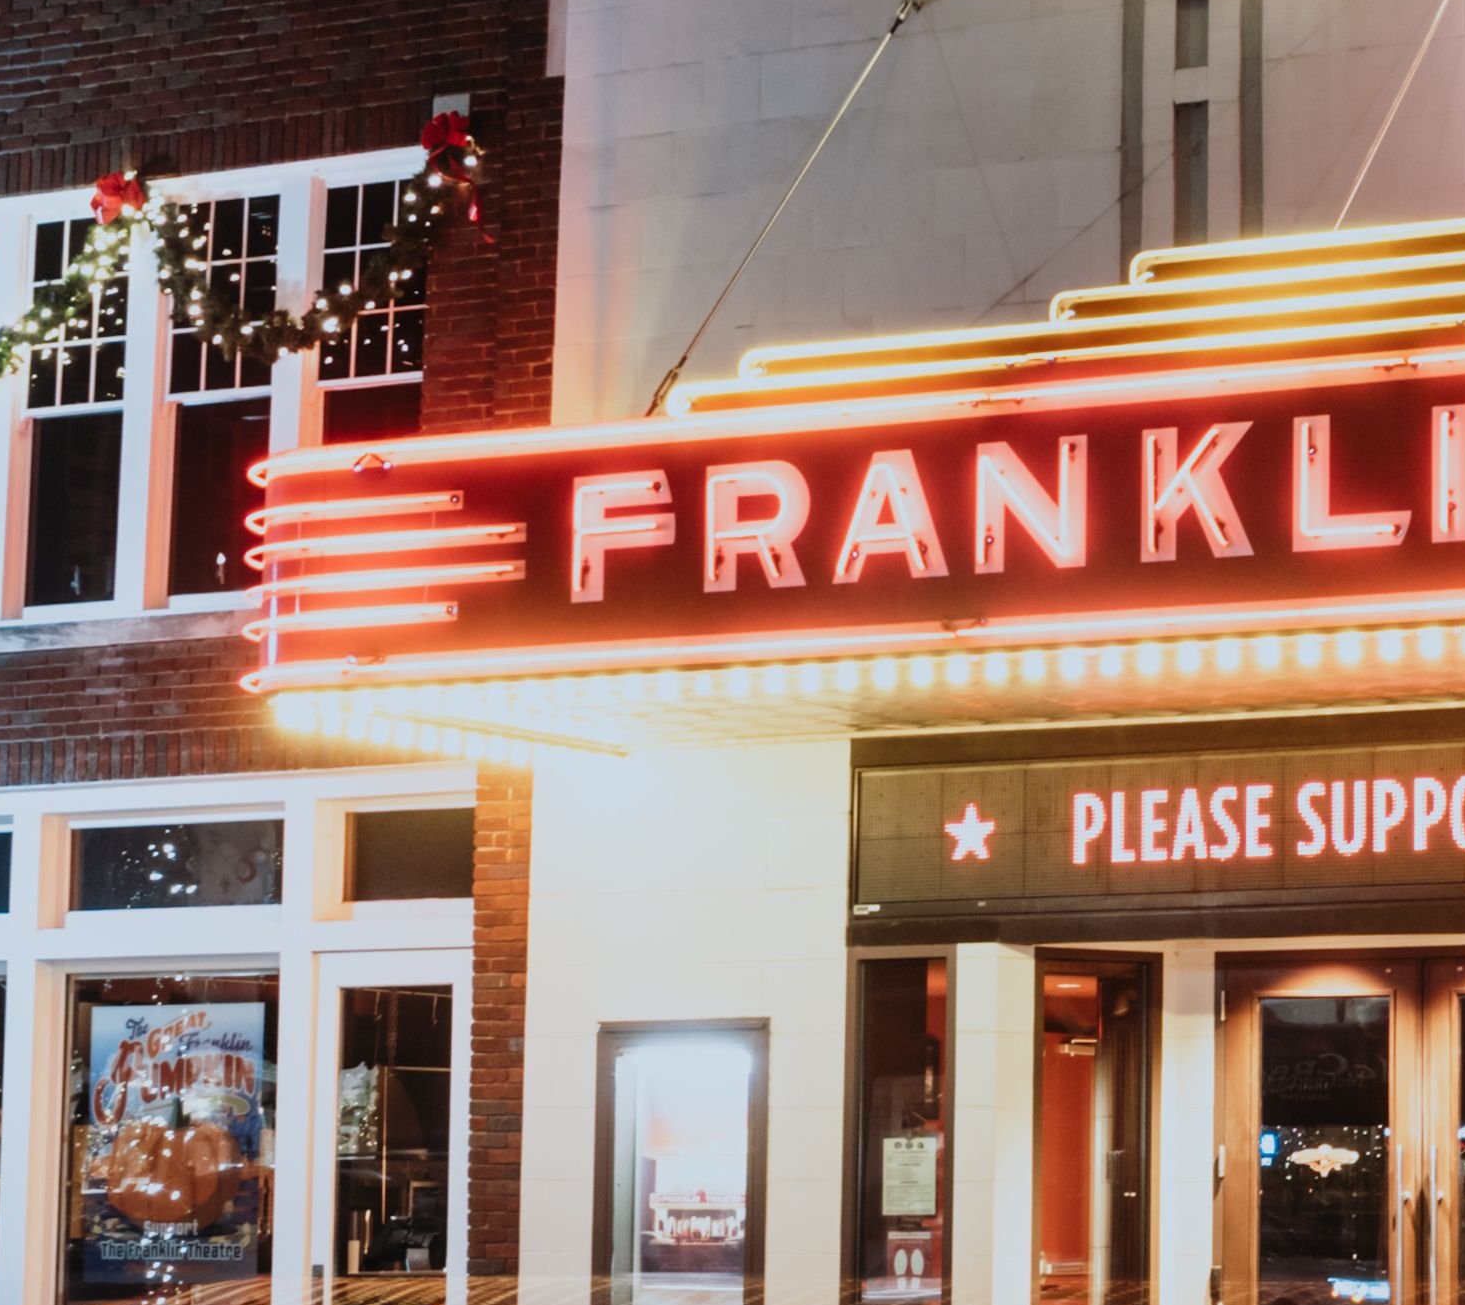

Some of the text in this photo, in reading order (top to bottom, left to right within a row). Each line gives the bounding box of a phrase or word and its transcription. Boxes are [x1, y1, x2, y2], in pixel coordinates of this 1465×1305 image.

[1073, 784, 1273, 864] PLEASE
[126, 1011, 207, 1059] The GREAT
[143, 1219, 199, 1236] Support
[100, 1240, 243, 1260] The Franklin Theatre
